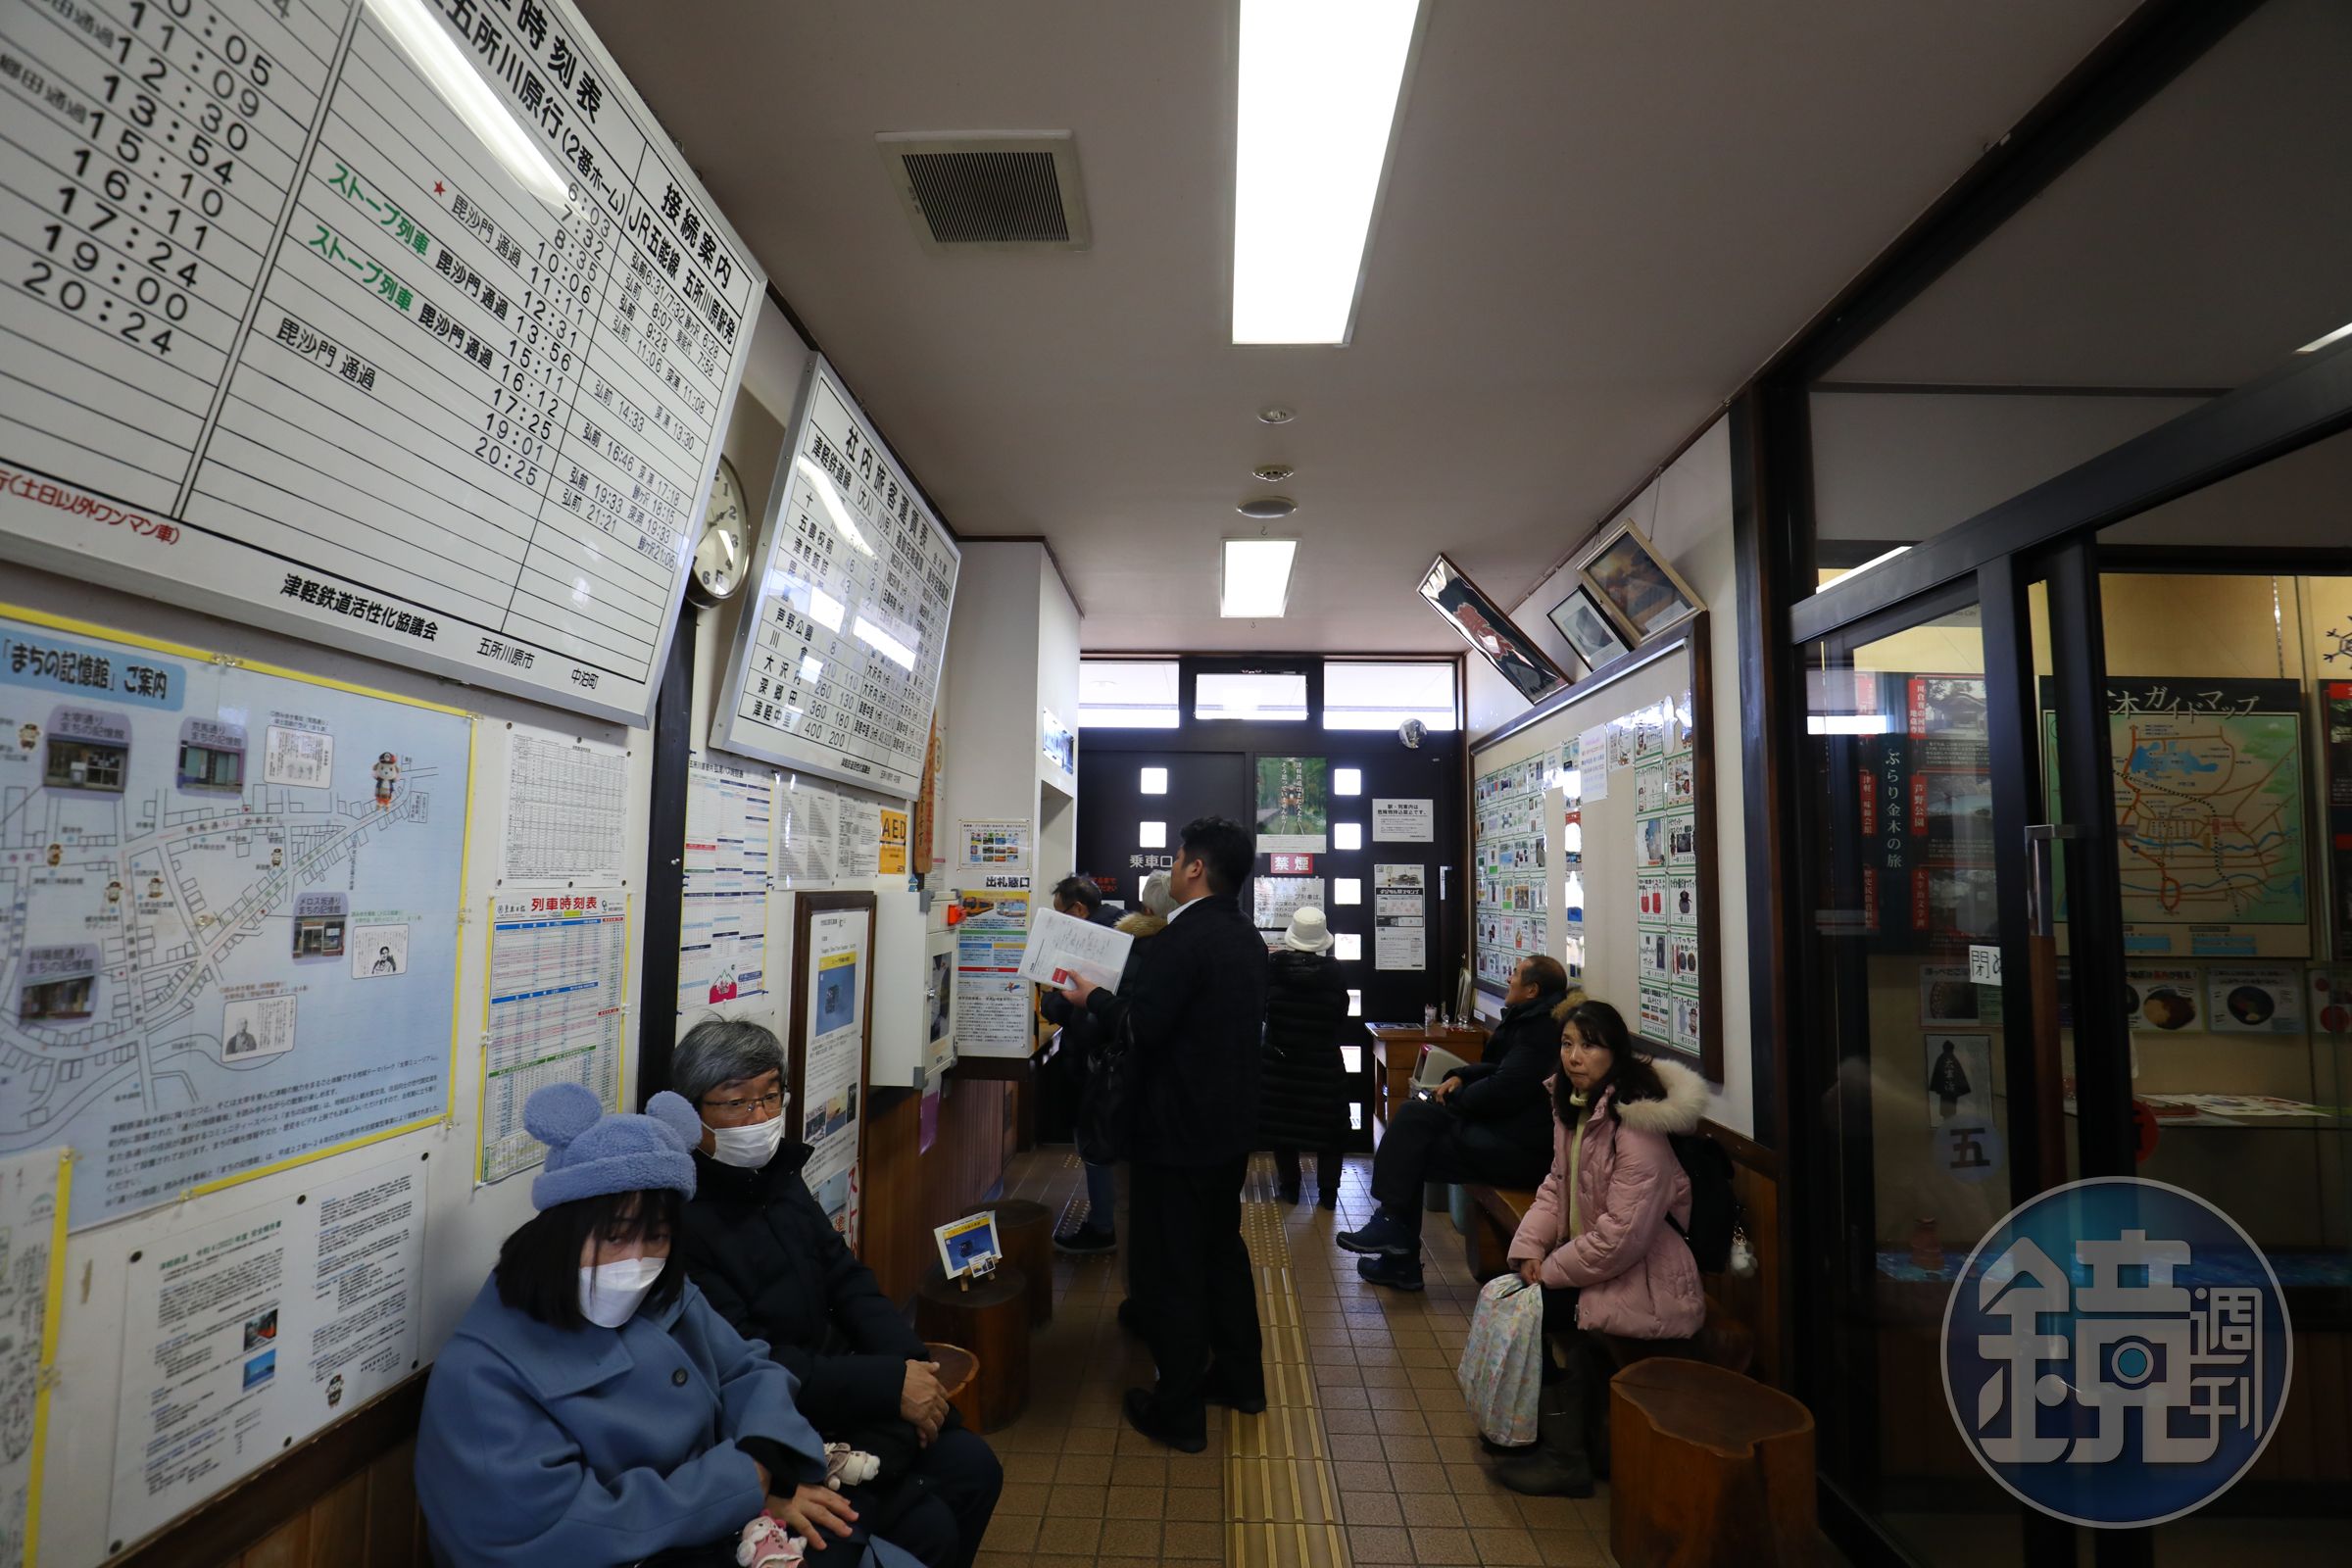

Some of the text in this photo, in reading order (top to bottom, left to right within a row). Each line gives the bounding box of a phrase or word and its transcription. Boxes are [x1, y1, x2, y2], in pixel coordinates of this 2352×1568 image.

[130, 2, 259, 118] 11:09
[169, 0, 272, 86] 0:05
[495, 0, 602, 123] 時刻表
[118, 37, 248, 151] 12:30
[437, 0, 625, 216] 五所川原行(2番ホーム)
[104, 75, 234, 185] 13:54
[89, 112, 223, 218] 15:10
[74, 150, 208, 251] 16:11
[562, 204, 604, 260] 7:32
[568, 182, 611, 237] 6:03
[59, 187, 198, 287] 17:24
[328, 163, 571, 371] ストーブ列車 毘沙門 通過 13:56
[452, 195, 584, 325] 毘沙門 通過 11:11
[555, 229, 598, 281] 8:35
[628, 206, 681, 281] JR五能線
[662, 182, 732, 290] 接続案内
[44, 224, 188, 320] 19:00
[538, 242, 591, 304] 10:06
[24, 262, 172, 355] 20:24
[309, 224, 559, 417] ストーブ列車 毘沙門 通過 16:12
[524, 291, 576, 348] 12:31
[619, 294, 668, 354] 弘前 9:28
[652, 302, 673, 332] 8:07
[697, 352, 715, 377] 7:58
[510, 340, 564, 393] 15:11
[612, 315, 631, 342] 弘前
[637, 339, 662, 373] 11:06
[684, 384, 706, 416] 11:08
[703, 331, 719, 359] 6:28
[276, 318, 538, 486] 毘沙門 通過 20:25
[494, 388, 552, 440] 17:25
[594, 379, 645, 433] 弘前 14:33
[487, 413, 543, 462] 19:01
[582, 422, 602, 448] 弘前
[607, 440, 635, 472] 16:46
[658, 480, 681, 507] 17:18
[673, 422, 695, 451] 13:30
[562, 488, 582, 513] 弘前
[587, 503, 618, 534] 21:21
[568, 466, 589, 492] 弘前
[594, 483, 624, 514] 19:33
[648, 518, 671, 544] 19:33
[652, 498, 676, 525] 18:15
[280, 573, 599, 690] 津軽鉄道活性化協議会 五所川原市 中泊町
[124, 666, 168, 700] ご案内
[808, 700, 826, 719] 360
[834, 711, 850, 729] 180
[813, 678, 832, 700] 260
[838, 691, 854, 710] 130
[2107, 686, 2260, 724] 木ガイドマップ
[804, 719, 822, 739] 400
[828, 729, 845, 748] 200
[882, 817, 906, 839] AED
[1886, 749, 1902, 868] ぶらり金木の旅
[1129, 855, 1173, 868] 乗車口
[1274, 857, 1309, 871] 禁煙
[531, 897, 597, 911] 列車時刻表
